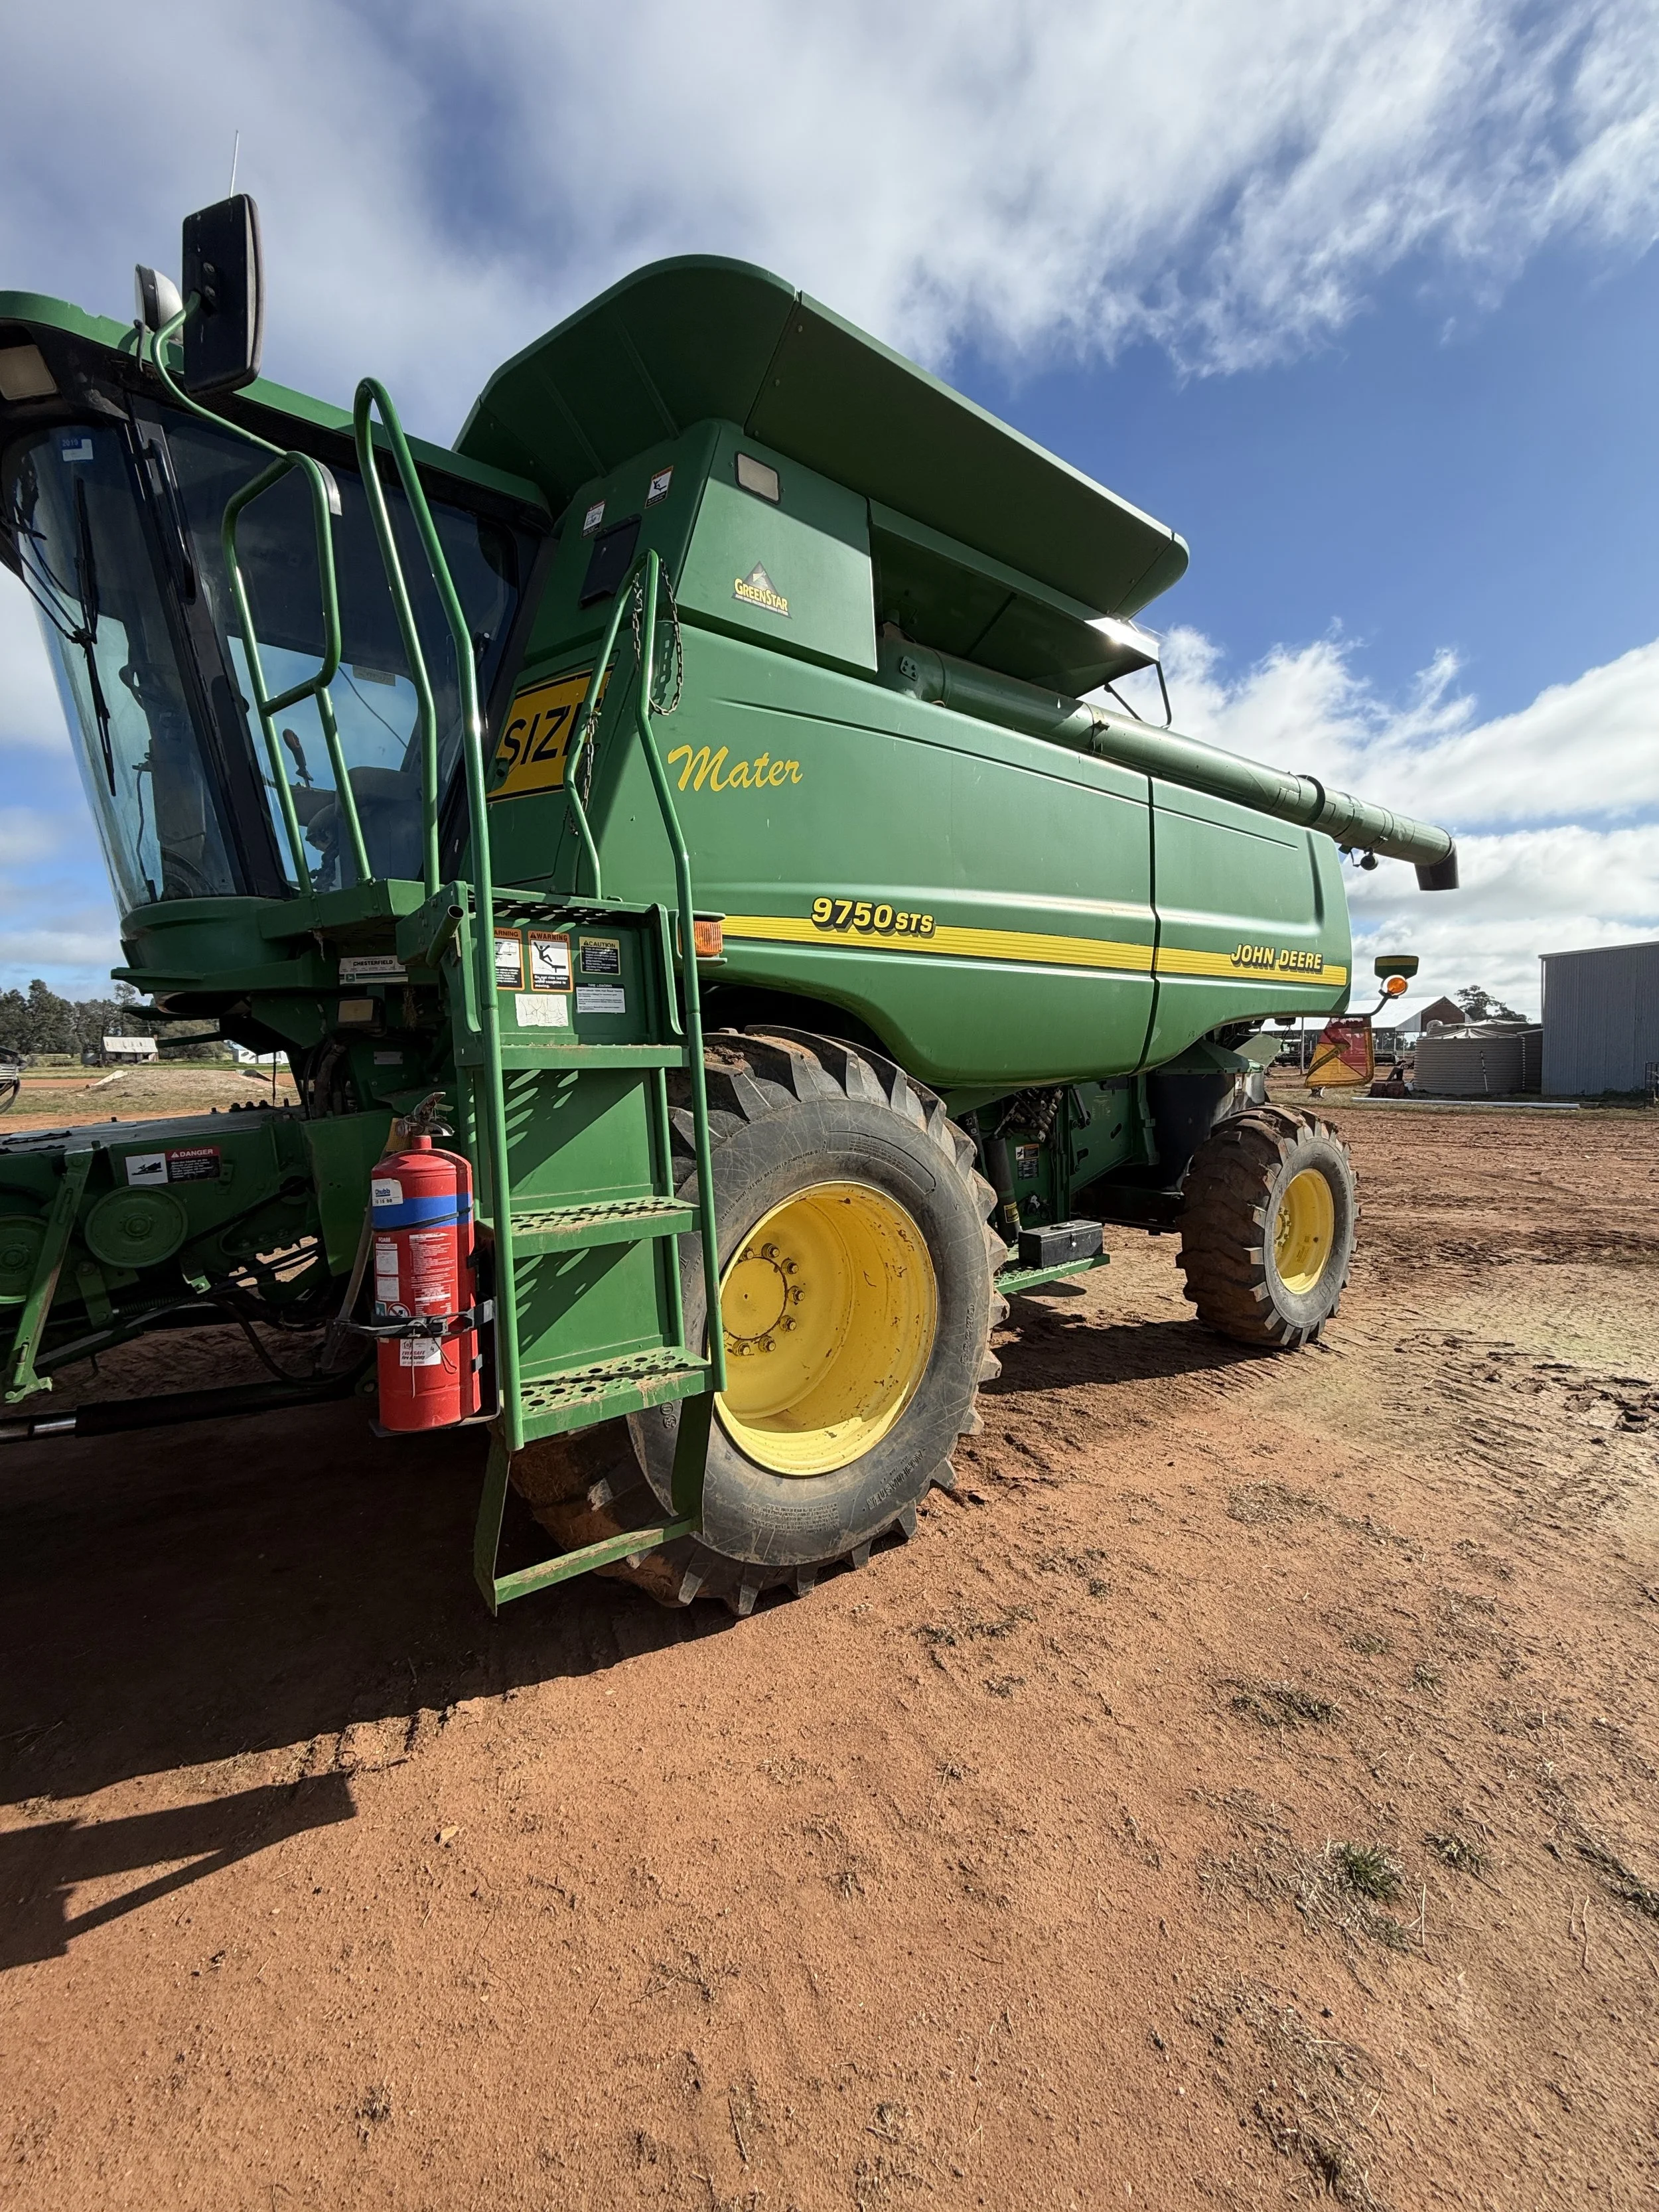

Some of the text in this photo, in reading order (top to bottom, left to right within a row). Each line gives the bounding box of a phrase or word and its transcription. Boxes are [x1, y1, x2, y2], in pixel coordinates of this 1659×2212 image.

[667, 743, 804, 792] Mater
[811, 896, 936, 936] 9750 STS
[1230, 943, 1323, 974] JOHN DEERE
[179, 1149, 213, 1157] DANGER
